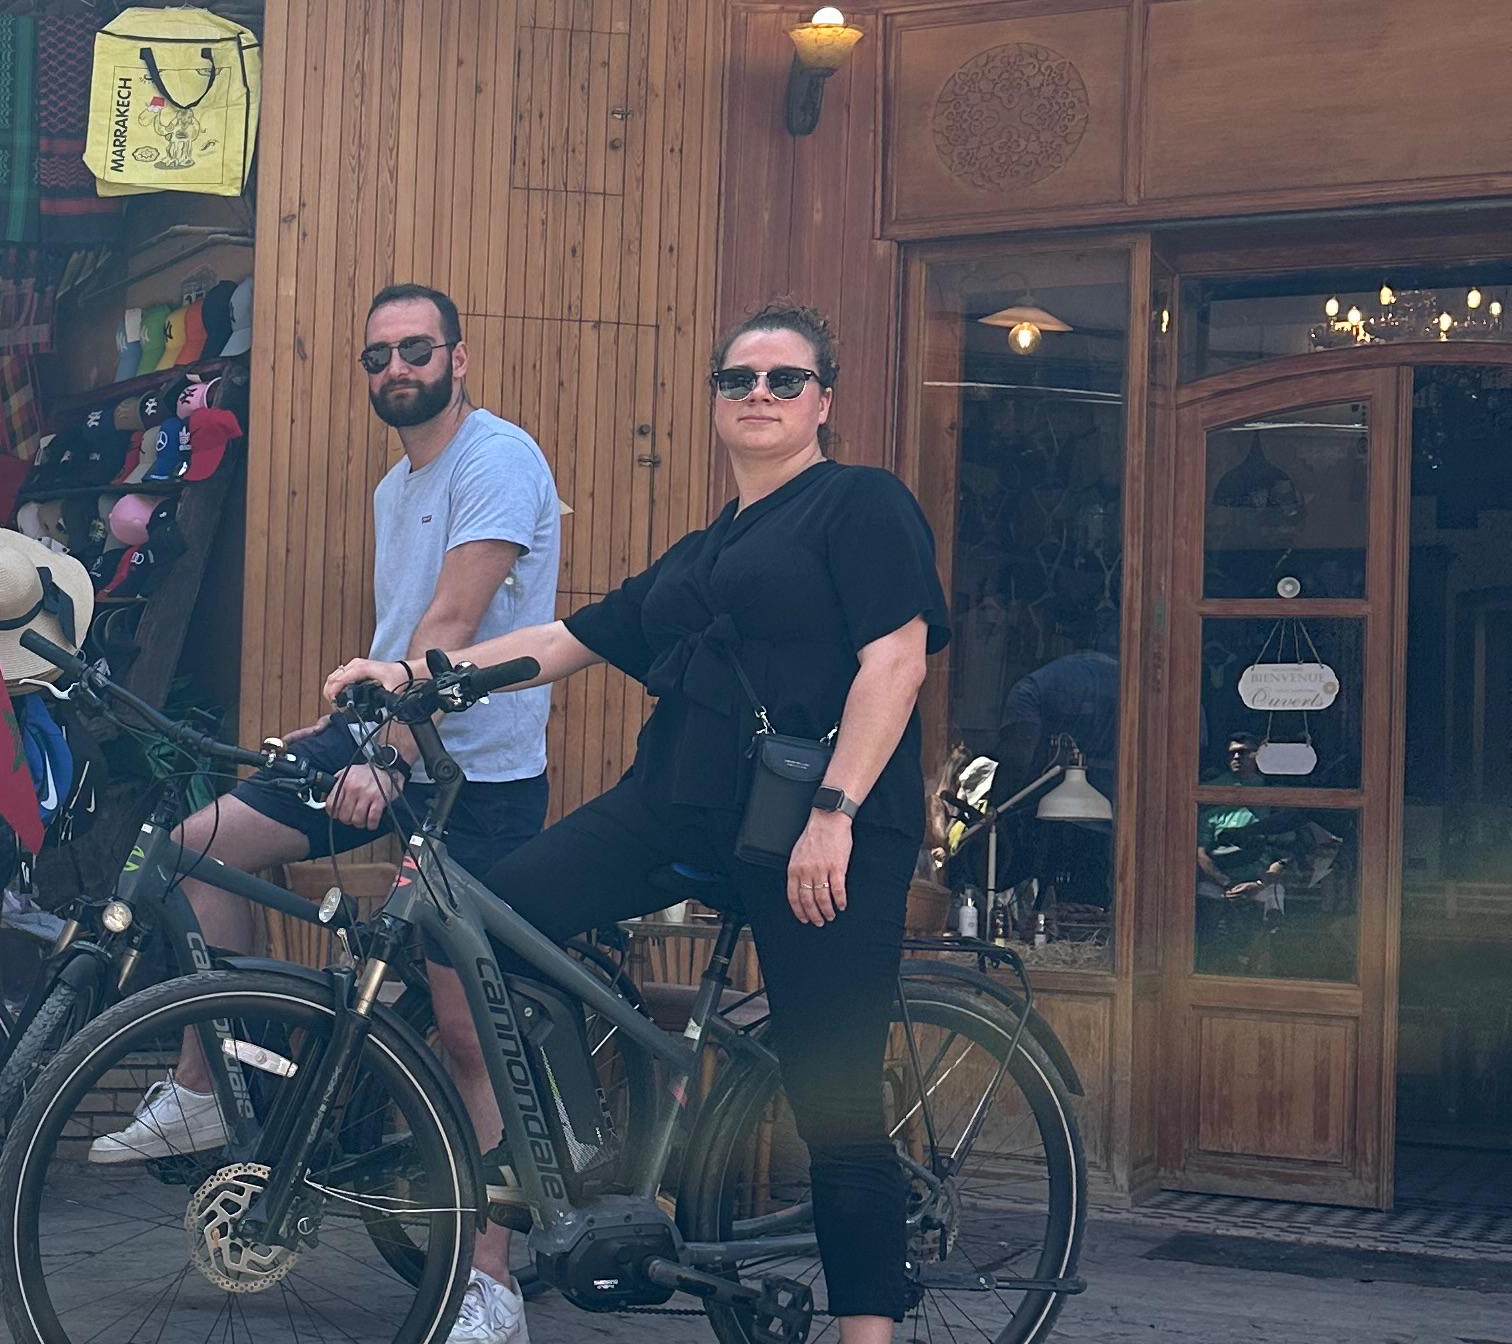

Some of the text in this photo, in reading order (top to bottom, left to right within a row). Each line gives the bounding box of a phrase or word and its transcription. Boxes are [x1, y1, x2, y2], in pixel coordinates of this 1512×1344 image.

[110, 77, 133, 173] MARRAKECH
[1250, 671, 1324, 683] BIENVENUE
[475, 956, 564, 1201] cannondale
